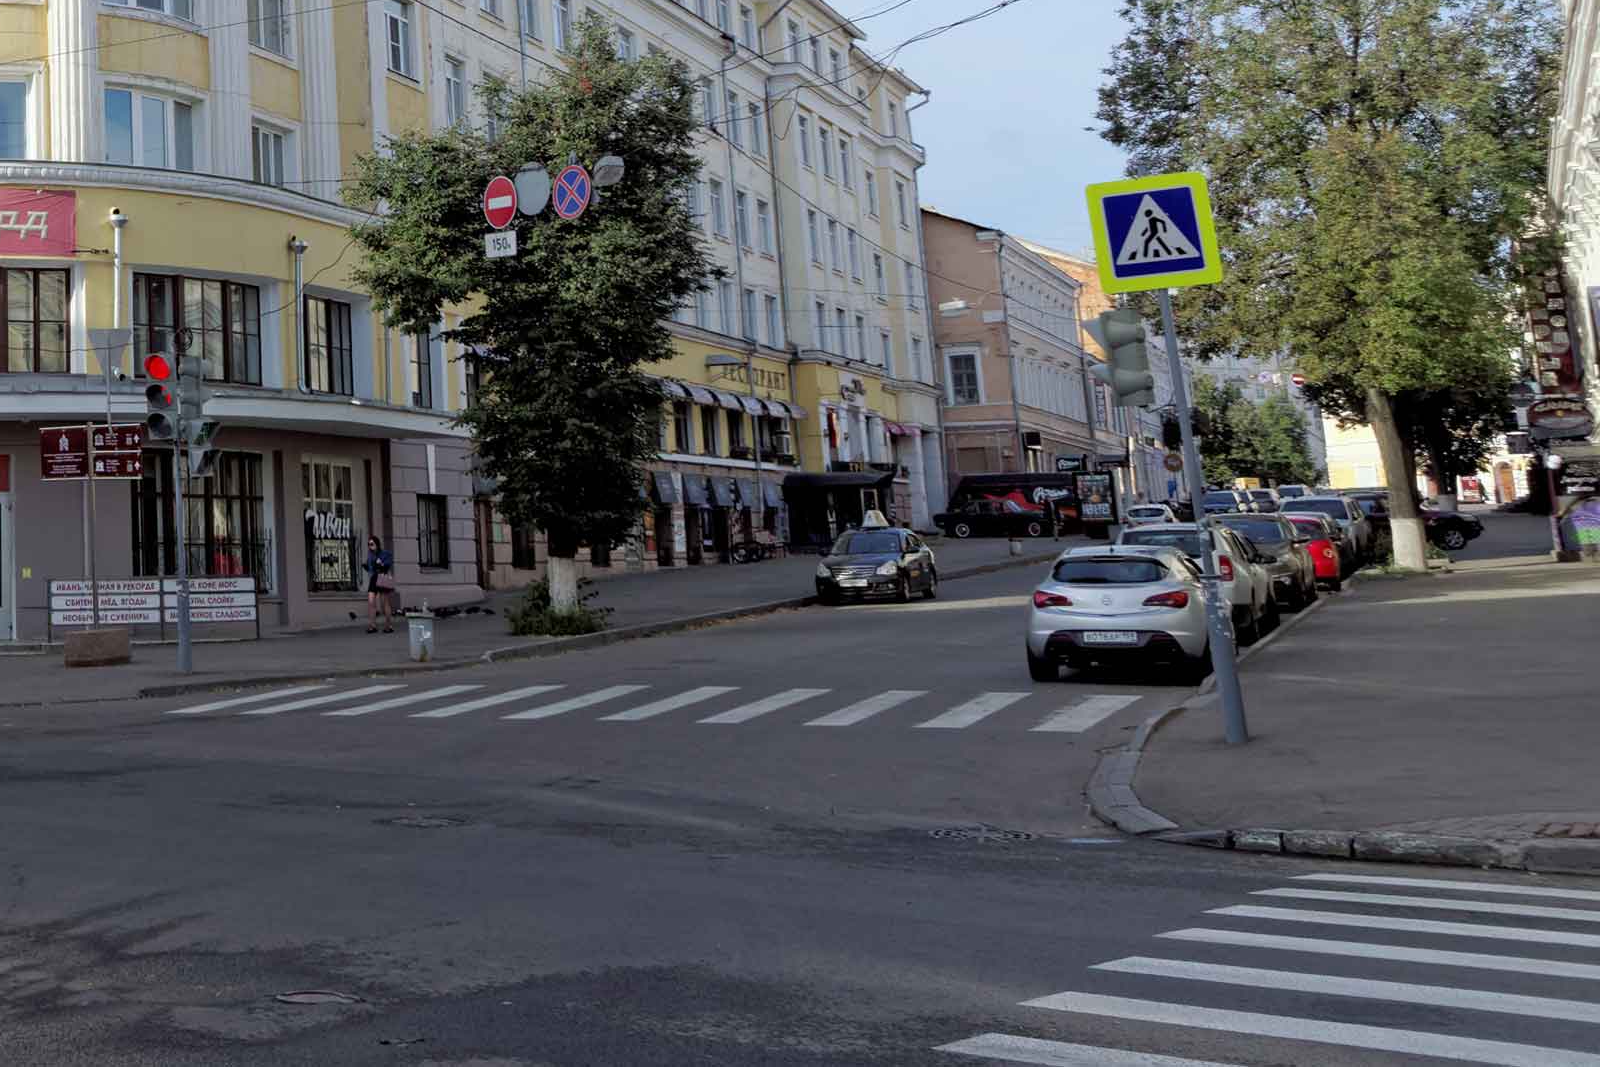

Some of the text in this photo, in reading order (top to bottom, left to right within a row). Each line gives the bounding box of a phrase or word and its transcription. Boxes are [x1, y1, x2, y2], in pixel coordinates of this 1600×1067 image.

[84, 582, 115, 591] ЧАНАЯ
[122, 582, 155, 590] РЕКОРДЕ
[63, 614, 108, 622] НЕОБЫЧЫЕ
